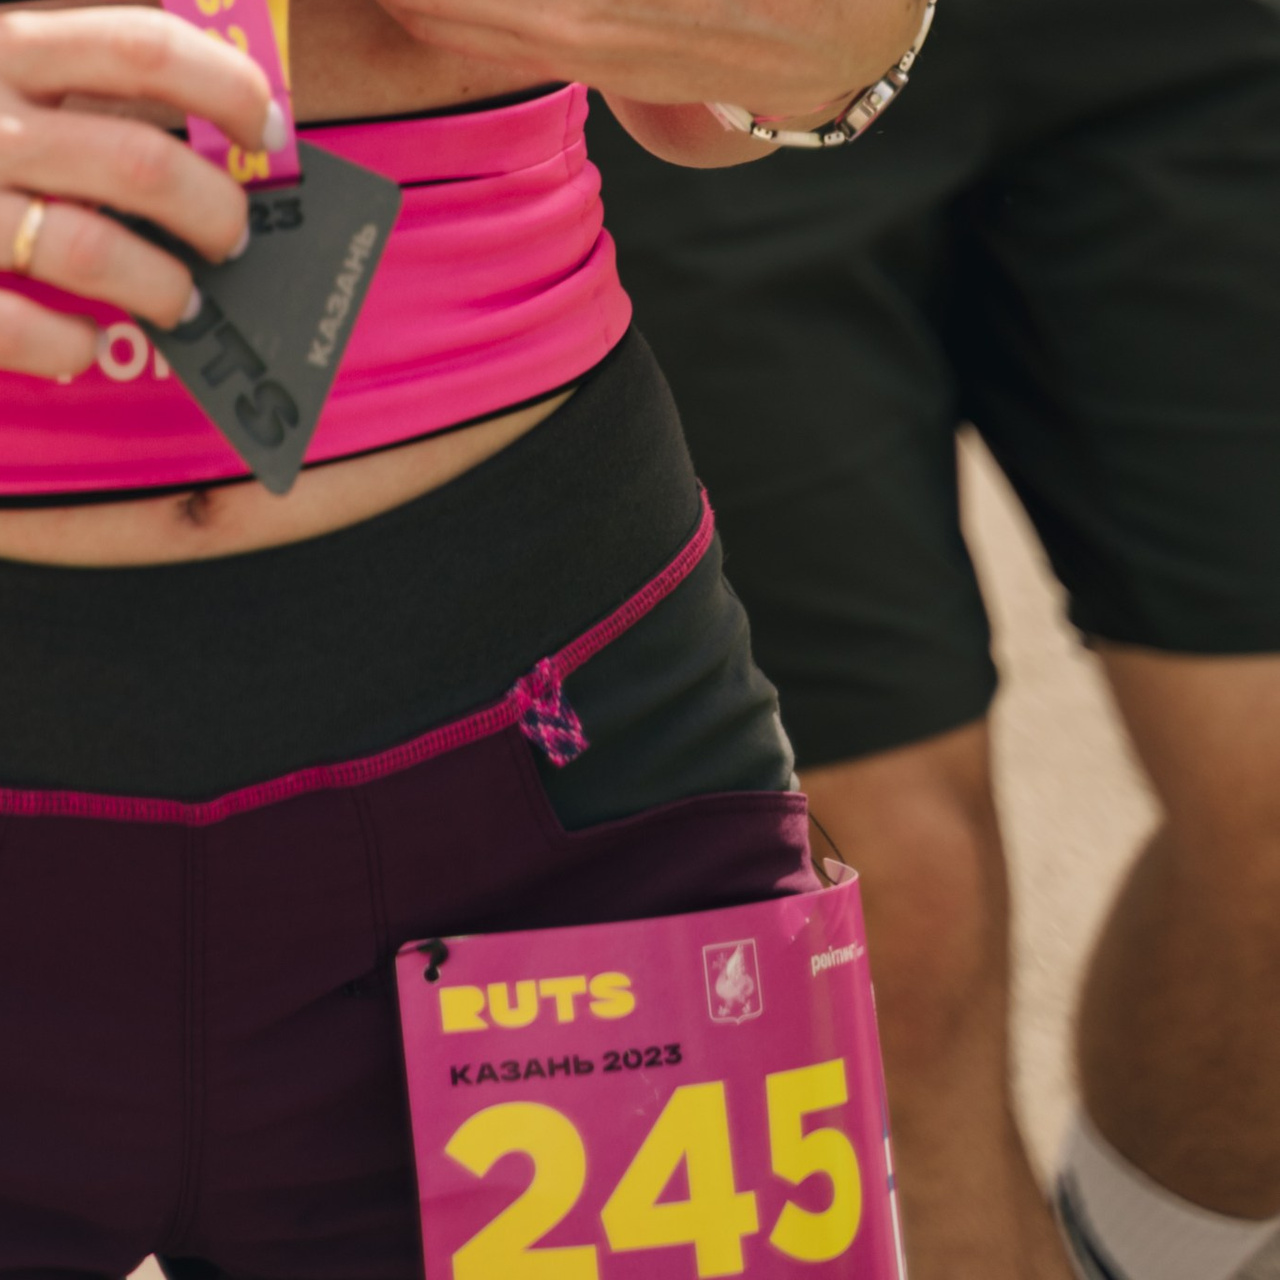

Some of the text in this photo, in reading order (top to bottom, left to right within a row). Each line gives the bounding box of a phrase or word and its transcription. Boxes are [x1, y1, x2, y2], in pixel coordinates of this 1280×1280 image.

[307, 223, 378, 367] КАЗАНЬ
[439, 971, 636, 1033] RUTS
[449, 1042, 684, 1087] КАЗАНЬ 2023
[444, 1057, 863, 1280] 245
